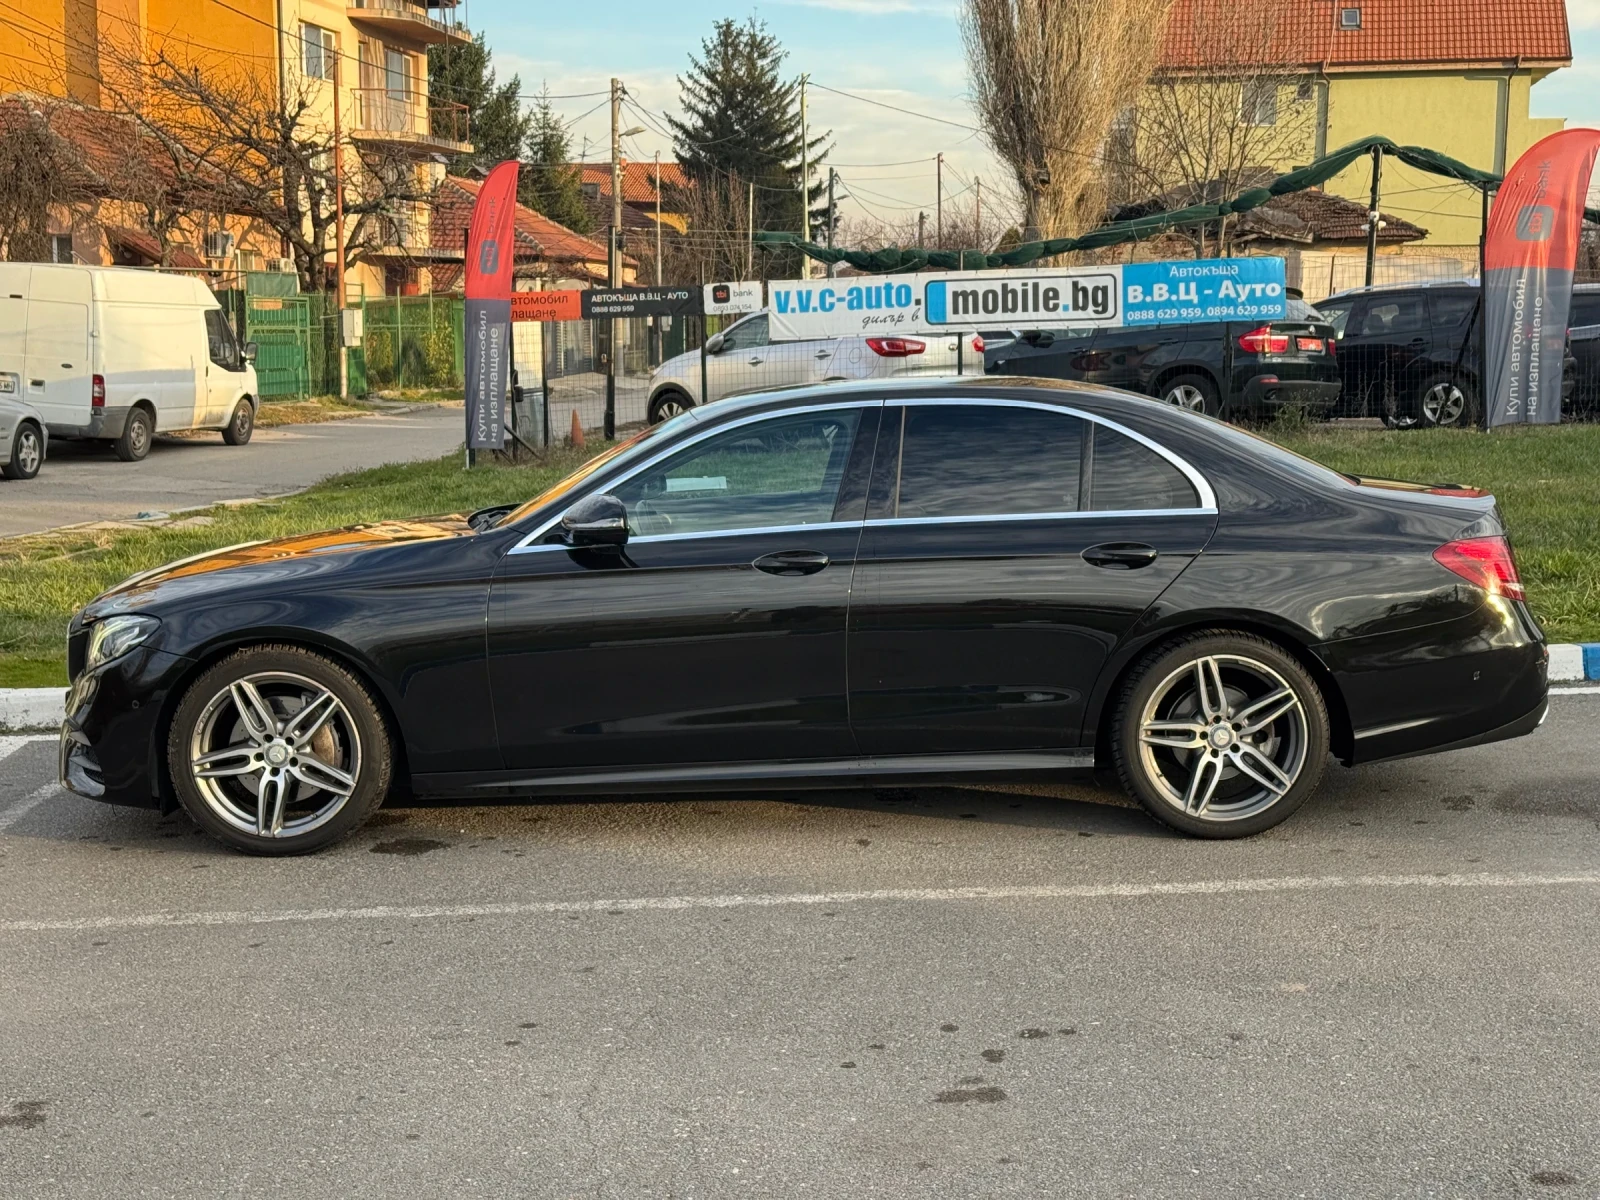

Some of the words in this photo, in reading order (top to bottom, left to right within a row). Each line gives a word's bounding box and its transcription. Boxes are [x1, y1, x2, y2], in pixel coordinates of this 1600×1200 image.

[1169, 265, 1239, 278] Автокъща
[510, 293, 569, 306] втомобил
[591, 292, 638, 303] АВТОКЪЩА
[639, 291, 661, 301] В.В.Ц
[667, 291, 689, 300] АУТО
[732, 289, 754, 297] bank
[951, 280, 1109, 315] mobile.bg
[1127, 281, 1199, 304] В.В.Ц
[1218, 279, 1282, 303] Ауто
[510, 309, 557, 319] лащане
[591, 305, 609, 313] 0888
[609, 305, 622, 313] 629
[1127, 309, 1155, 321] 0888
[1157, 308, 1178, 319] 629
[1180, 307, 1205, 319] 959,
[1206, 306, 1235, 317] 0894
[1237, 305, 1258, 315] 629
[1260, 304, 1282, 314] 959
[1510, 278, 1526, 372] автомобил
[1528, 296, 1543, 388] изплащане
[478, 310, 487, 400] автомобил
[490, 327, 500, 419] изплащане
[1506, 376, 1521, 416] Купи
[1527, 396, 1537, 416] на
[478, 404, 488, 441] Купи
[490, 423, 498, 442] на
